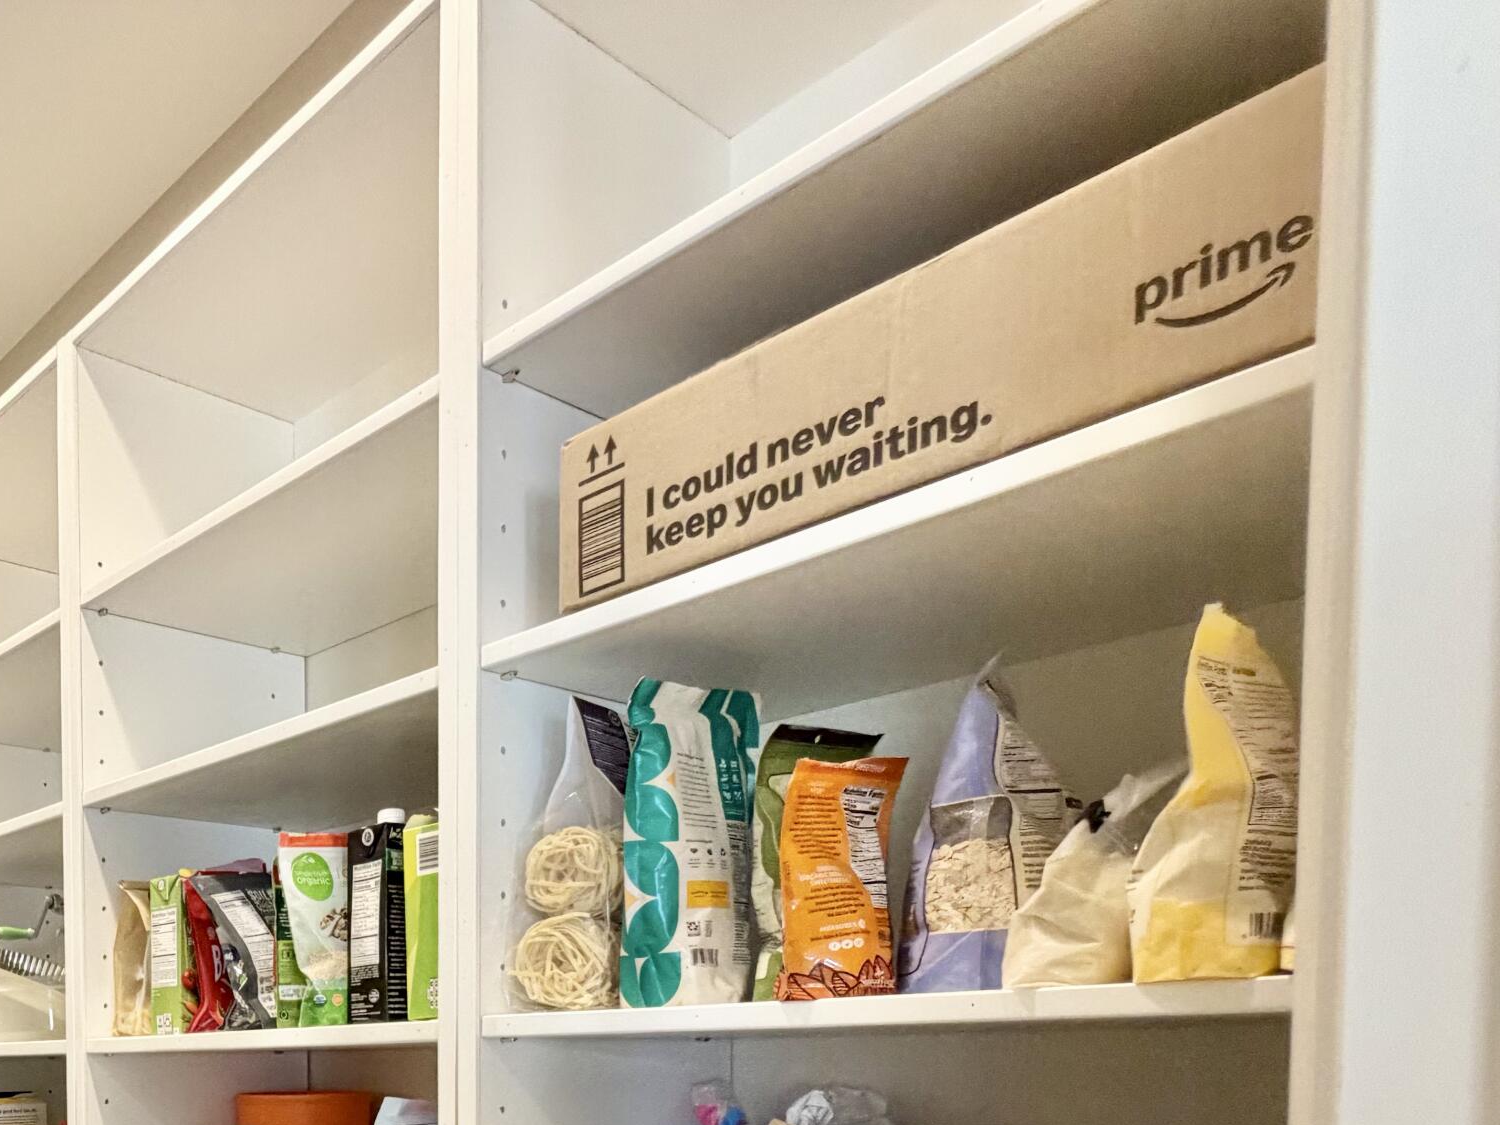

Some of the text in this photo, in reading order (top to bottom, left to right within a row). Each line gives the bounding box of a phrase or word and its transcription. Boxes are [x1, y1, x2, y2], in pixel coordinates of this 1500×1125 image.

[1134, 215, 1314, 325] prime
[645, 400, 993, 557] keep you waiting.
[646, 396, 886, 518] I could never
